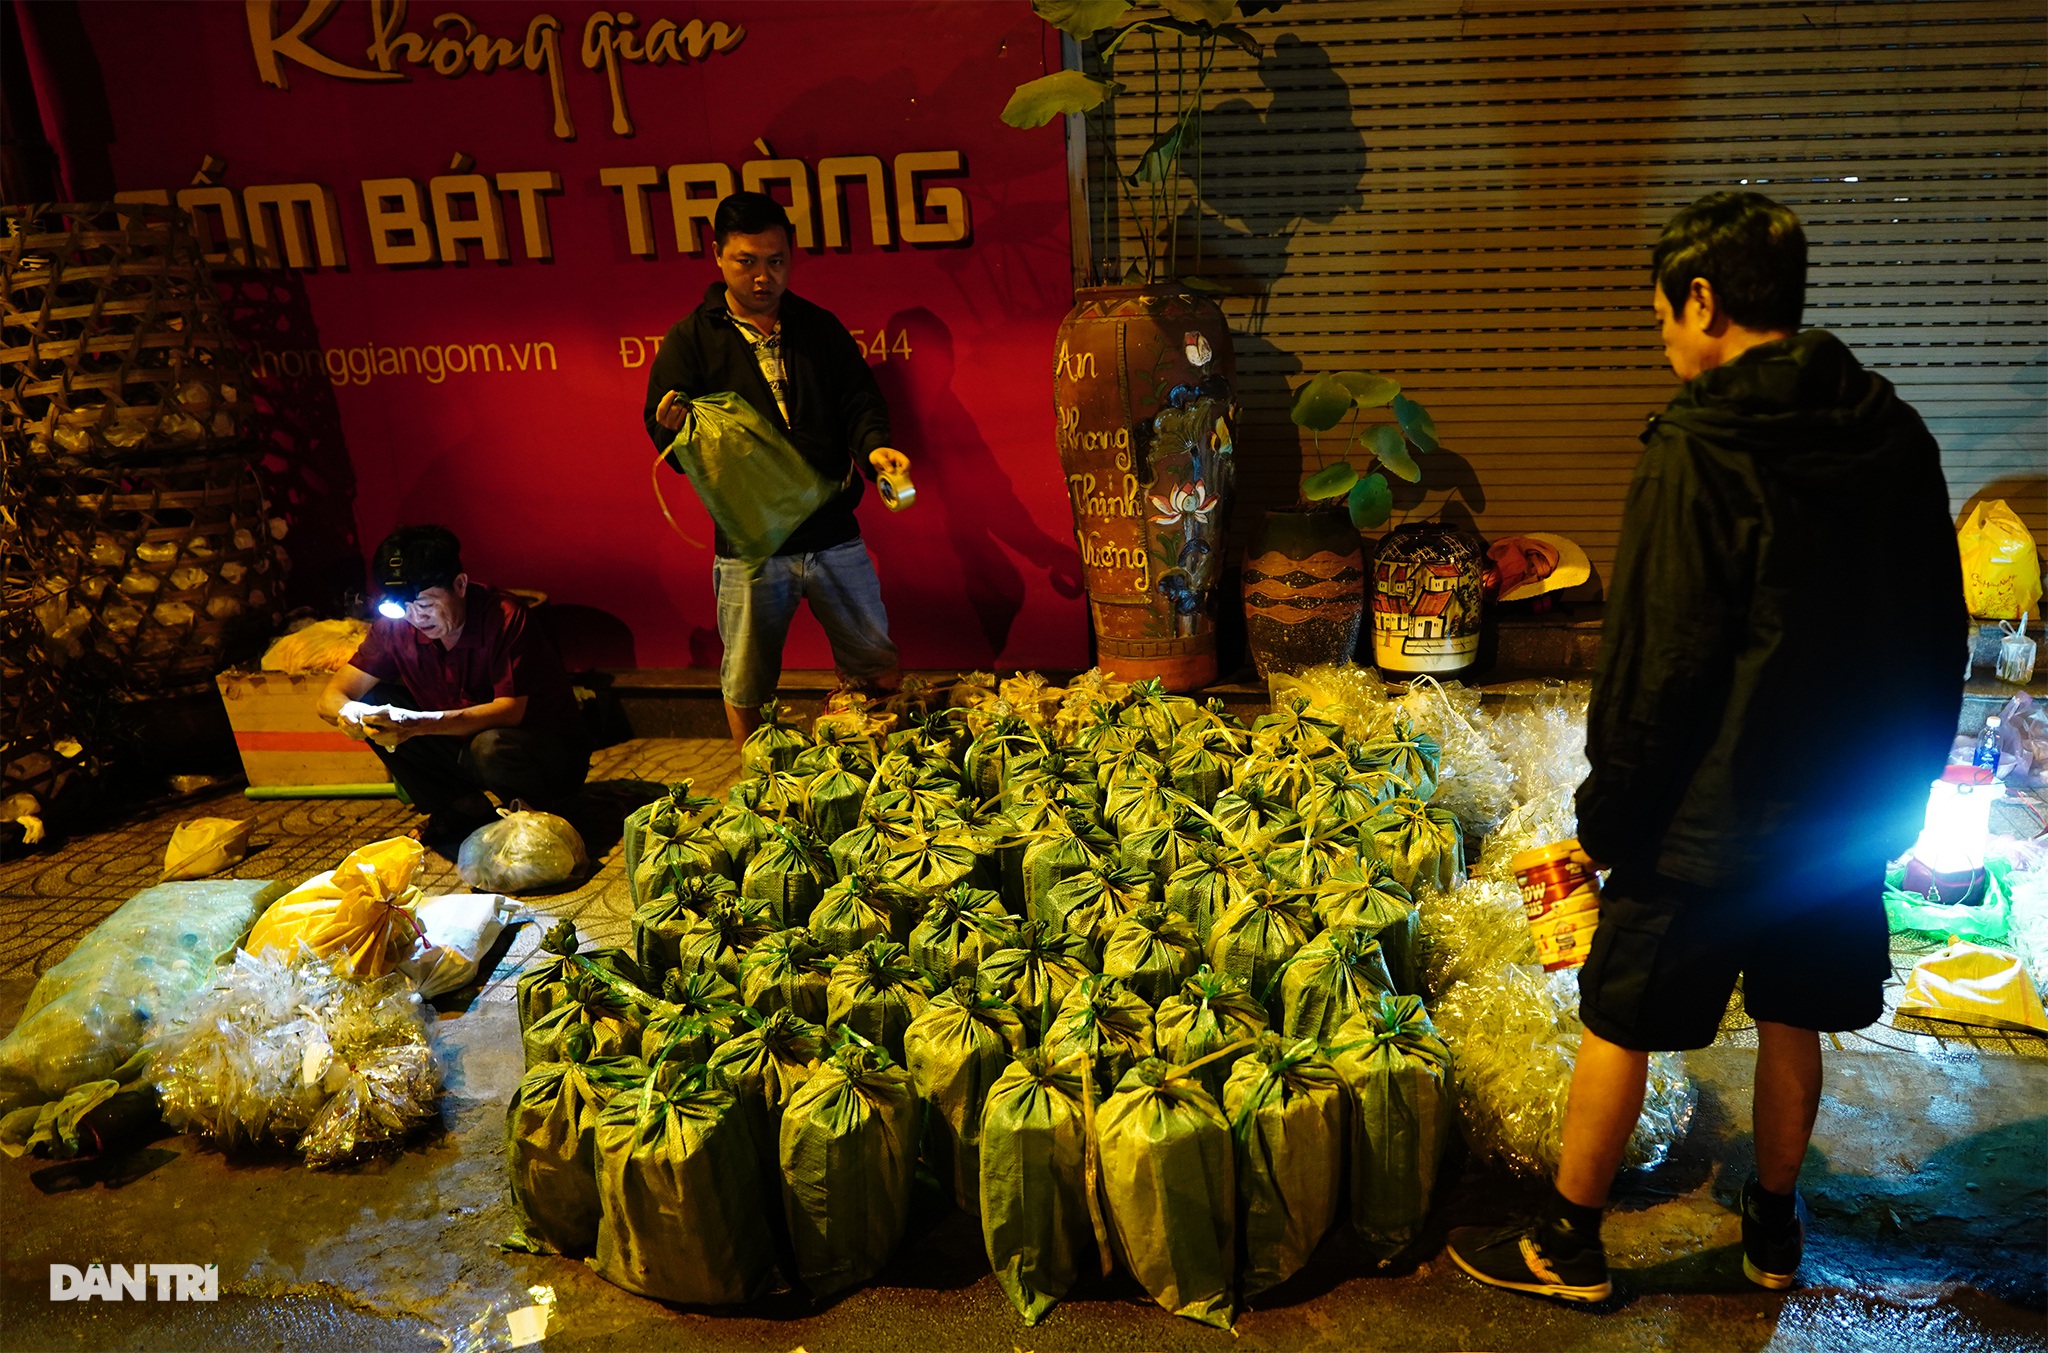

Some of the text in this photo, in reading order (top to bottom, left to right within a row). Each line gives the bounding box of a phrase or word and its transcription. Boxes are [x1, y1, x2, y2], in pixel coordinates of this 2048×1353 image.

[246, 0, 746, 139] Không gian
[361, 151, 561, 265] BÁT
[600, 137, 969, 255] TRÀNG
[1056, 338, 1099, 382] An
